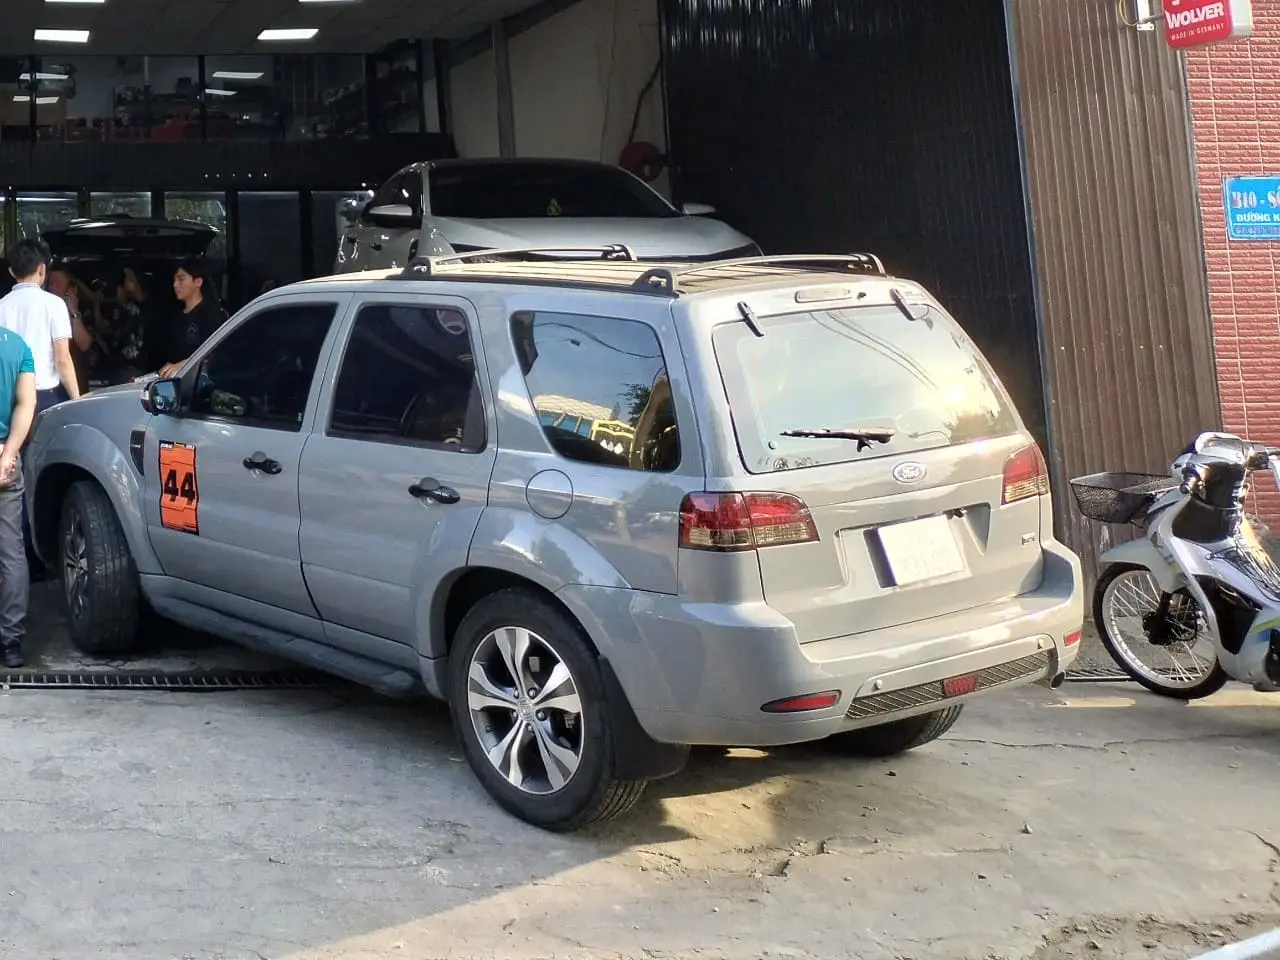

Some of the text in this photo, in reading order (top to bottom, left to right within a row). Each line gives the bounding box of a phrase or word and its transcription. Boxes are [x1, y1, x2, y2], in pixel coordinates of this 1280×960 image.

[1164, 1, 1225, 29] WOLVER
[1171, 31, 1186, 41] MADE
[1196, 23, 1225, 35] GERMANY
[164, 469, 195, 506] 44
